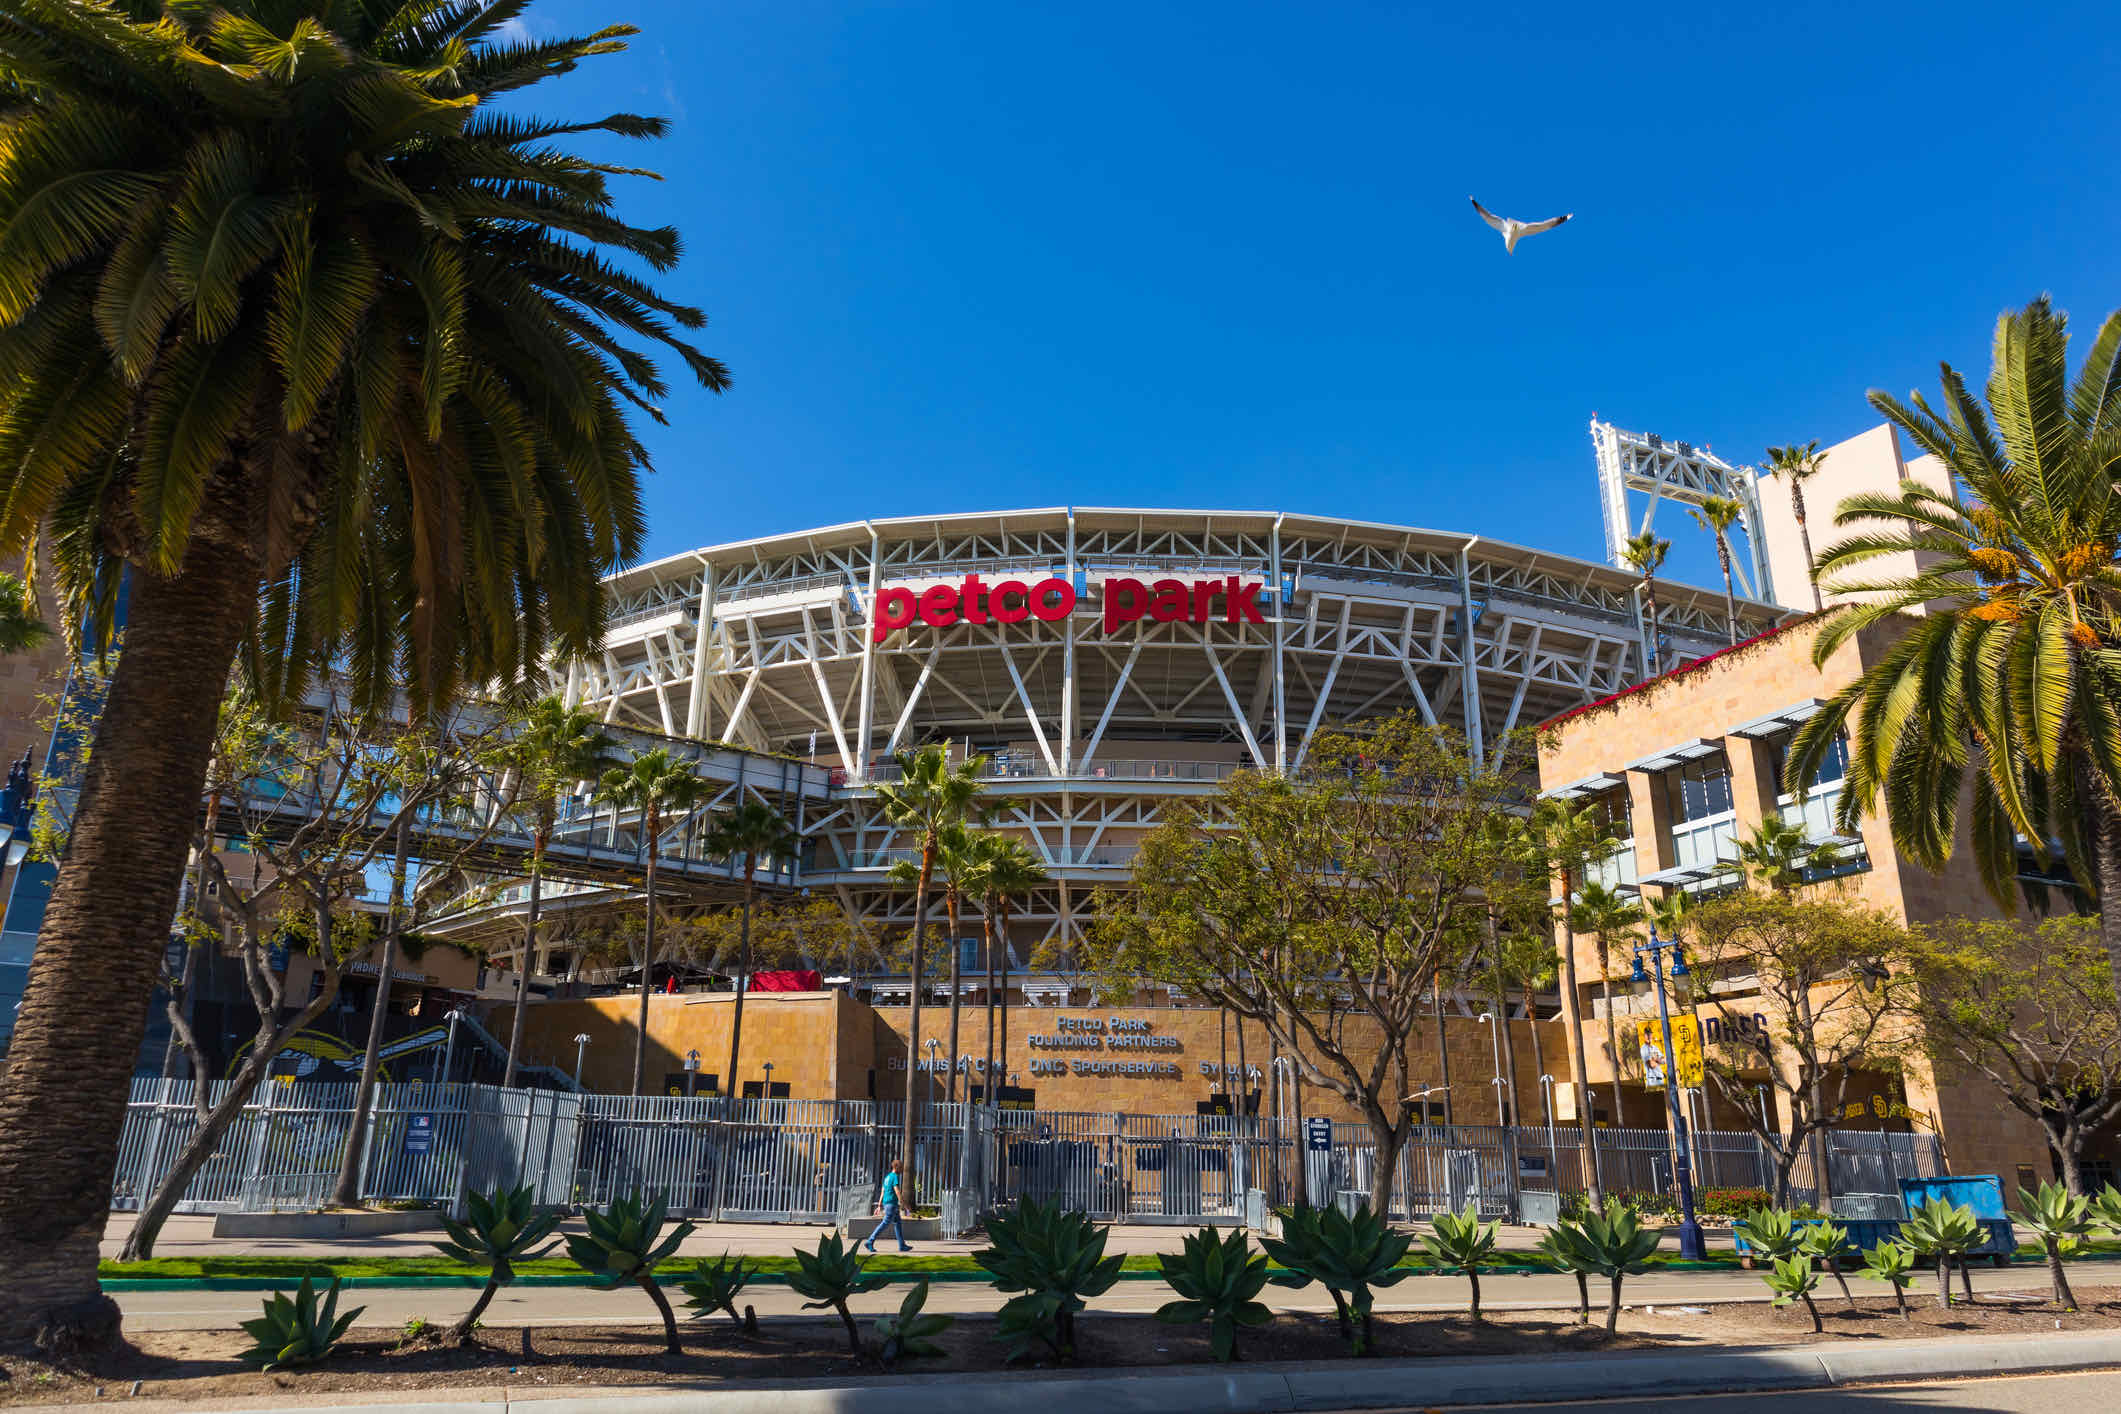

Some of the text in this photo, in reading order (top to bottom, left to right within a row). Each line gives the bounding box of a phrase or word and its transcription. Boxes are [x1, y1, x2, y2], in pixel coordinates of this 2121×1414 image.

[873, 574, 1266, 642] petco park
[1057, 1015, 1147, 1031] PETCO PARK
[1027, 1033, 1177, 1048] FOUNDING PARTNERS
[1029, 1058, 1177, 1073] DNC SPORTSERVICE
